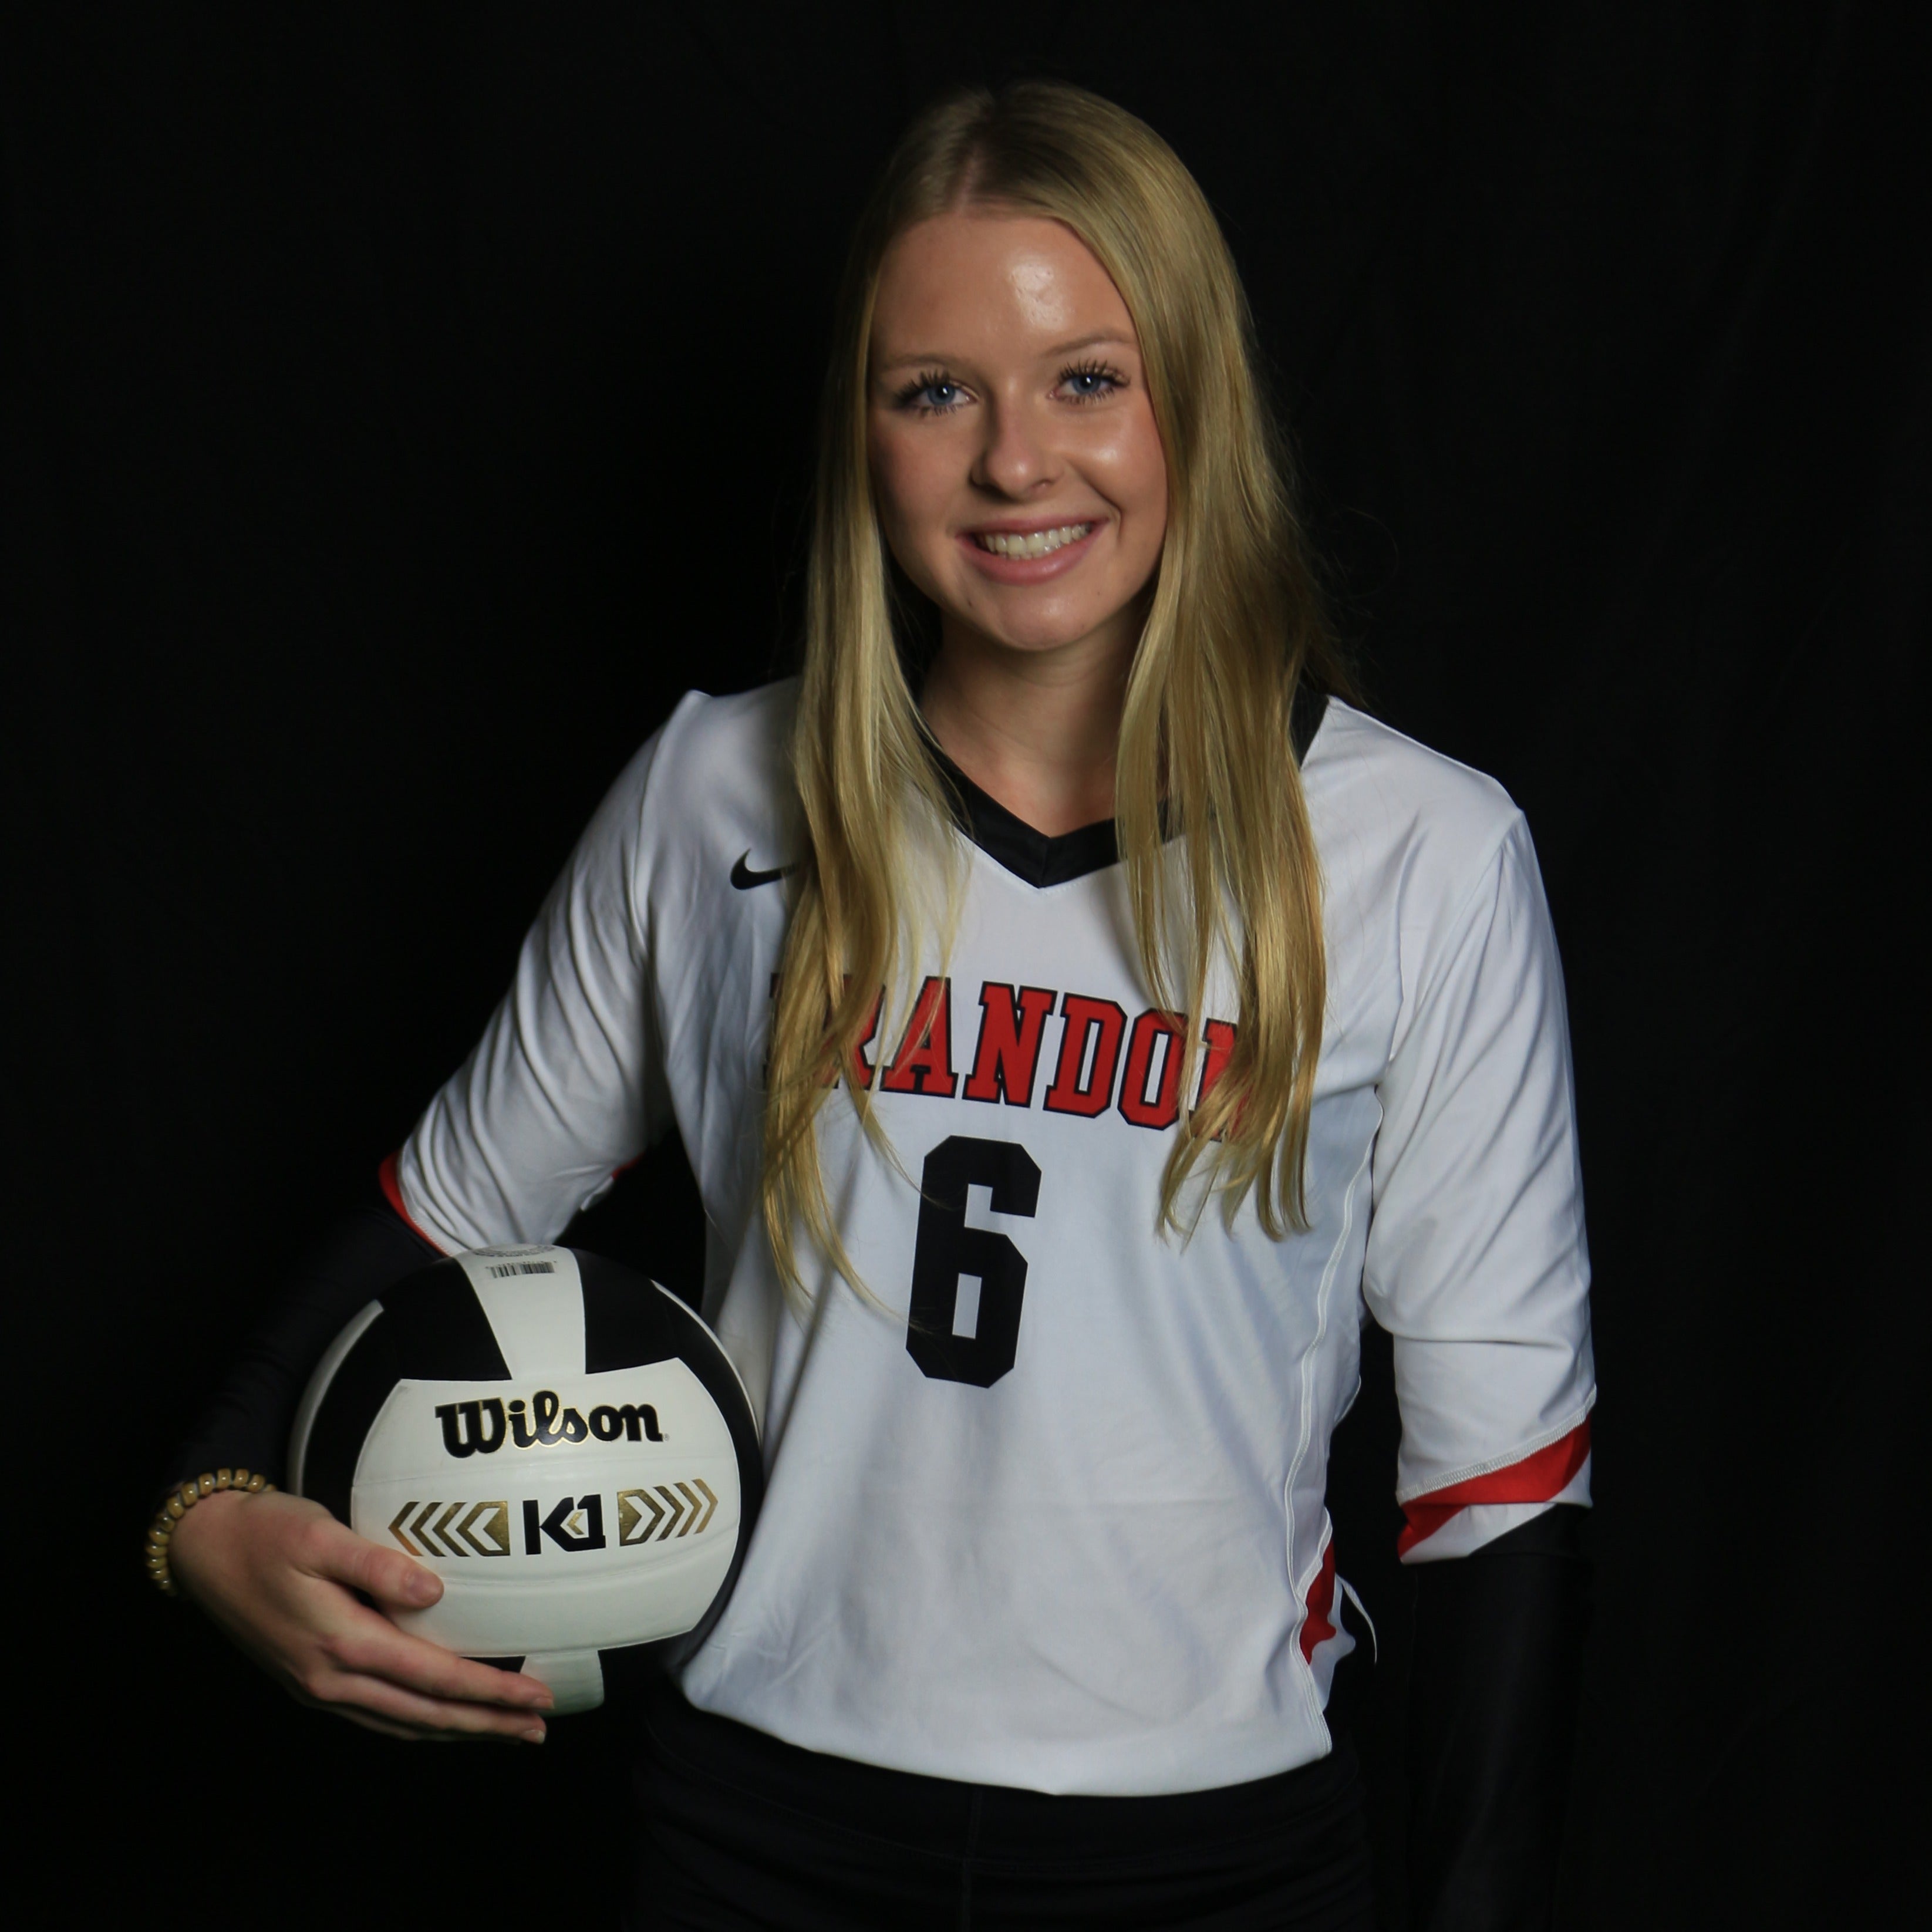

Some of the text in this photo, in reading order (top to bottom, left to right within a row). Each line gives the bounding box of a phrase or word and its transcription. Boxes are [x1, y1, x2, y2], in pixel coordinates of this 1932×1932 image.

[764, 972, 1255, 1142] RANDO
[906, 1135, 1042, 1388] 6
[434, 1390, 664, 1458] Wilson
[522, 1494, 606, 1556] K1
